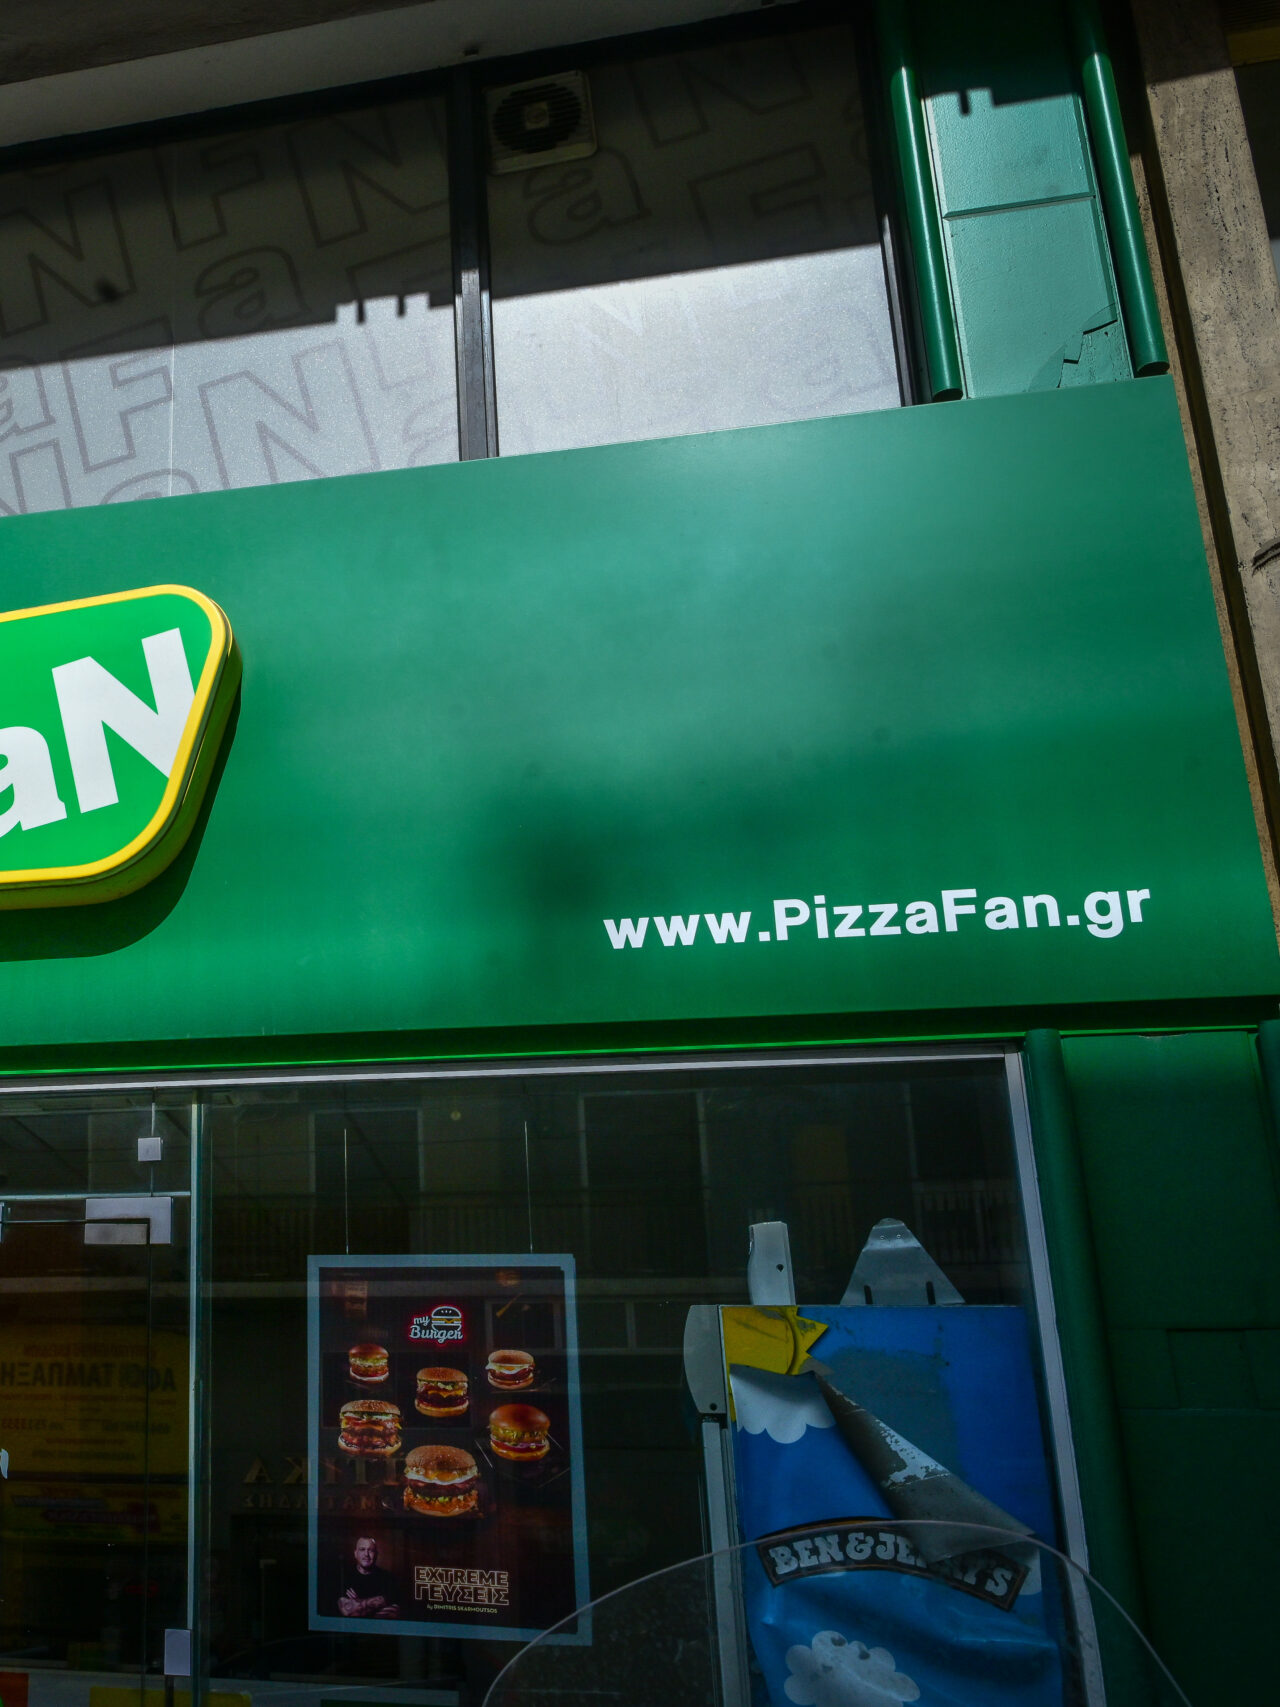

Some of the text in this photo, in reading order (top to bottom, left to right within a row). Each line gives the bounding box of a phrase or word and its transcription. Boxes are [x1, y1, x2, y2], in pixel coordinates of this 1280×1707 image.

[603, 888, 1151, 949] www.PizzaFan.gr
[409, 1325, 464, 1344] Burger
[414, 1566, 509, 1588] EXTREME
[414, 1582, 510, 1606] ΓΕΥΣΕΙΣ
